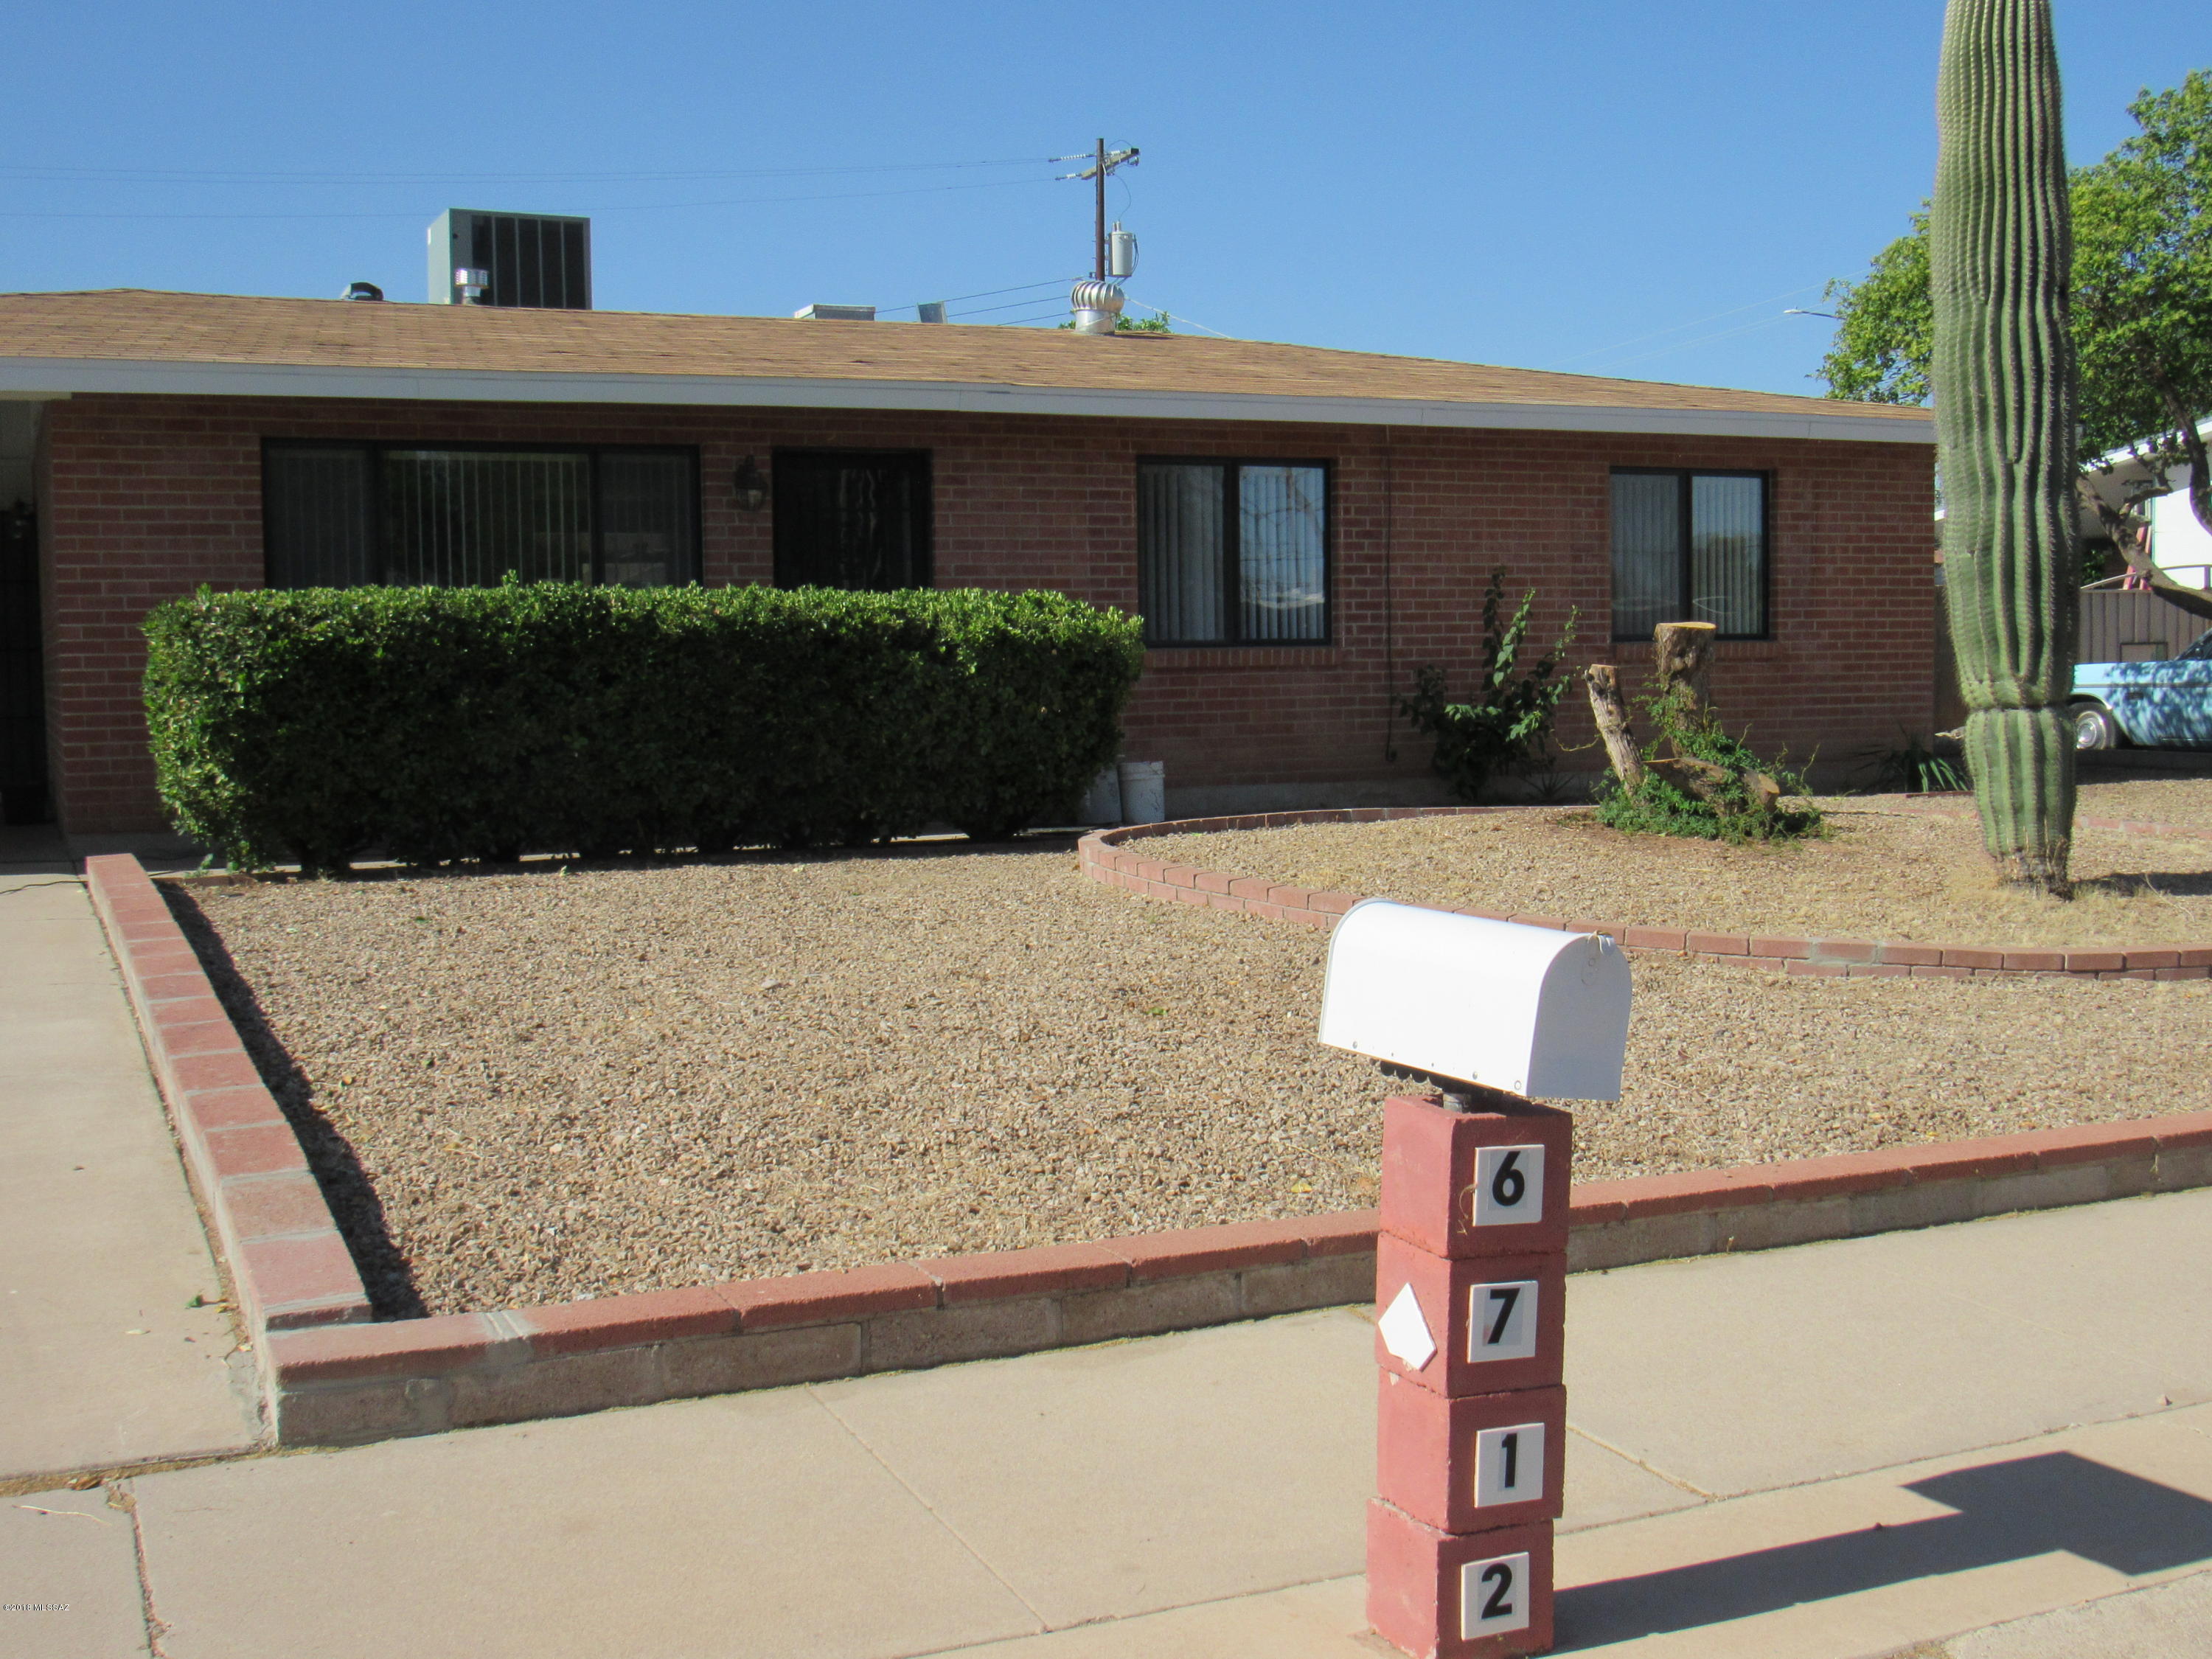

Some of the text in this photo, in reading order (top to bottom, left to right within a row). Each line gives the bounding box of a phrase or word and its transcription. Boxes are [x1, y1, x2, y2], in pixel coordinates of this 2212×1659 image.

[1492, 1151, 1525, 1206] 6
[1487, 1288, 1520, 1344] 7
[1502, 1433, 1517, 1488] 1
[1481, 1562, 1512, 1620] 2
